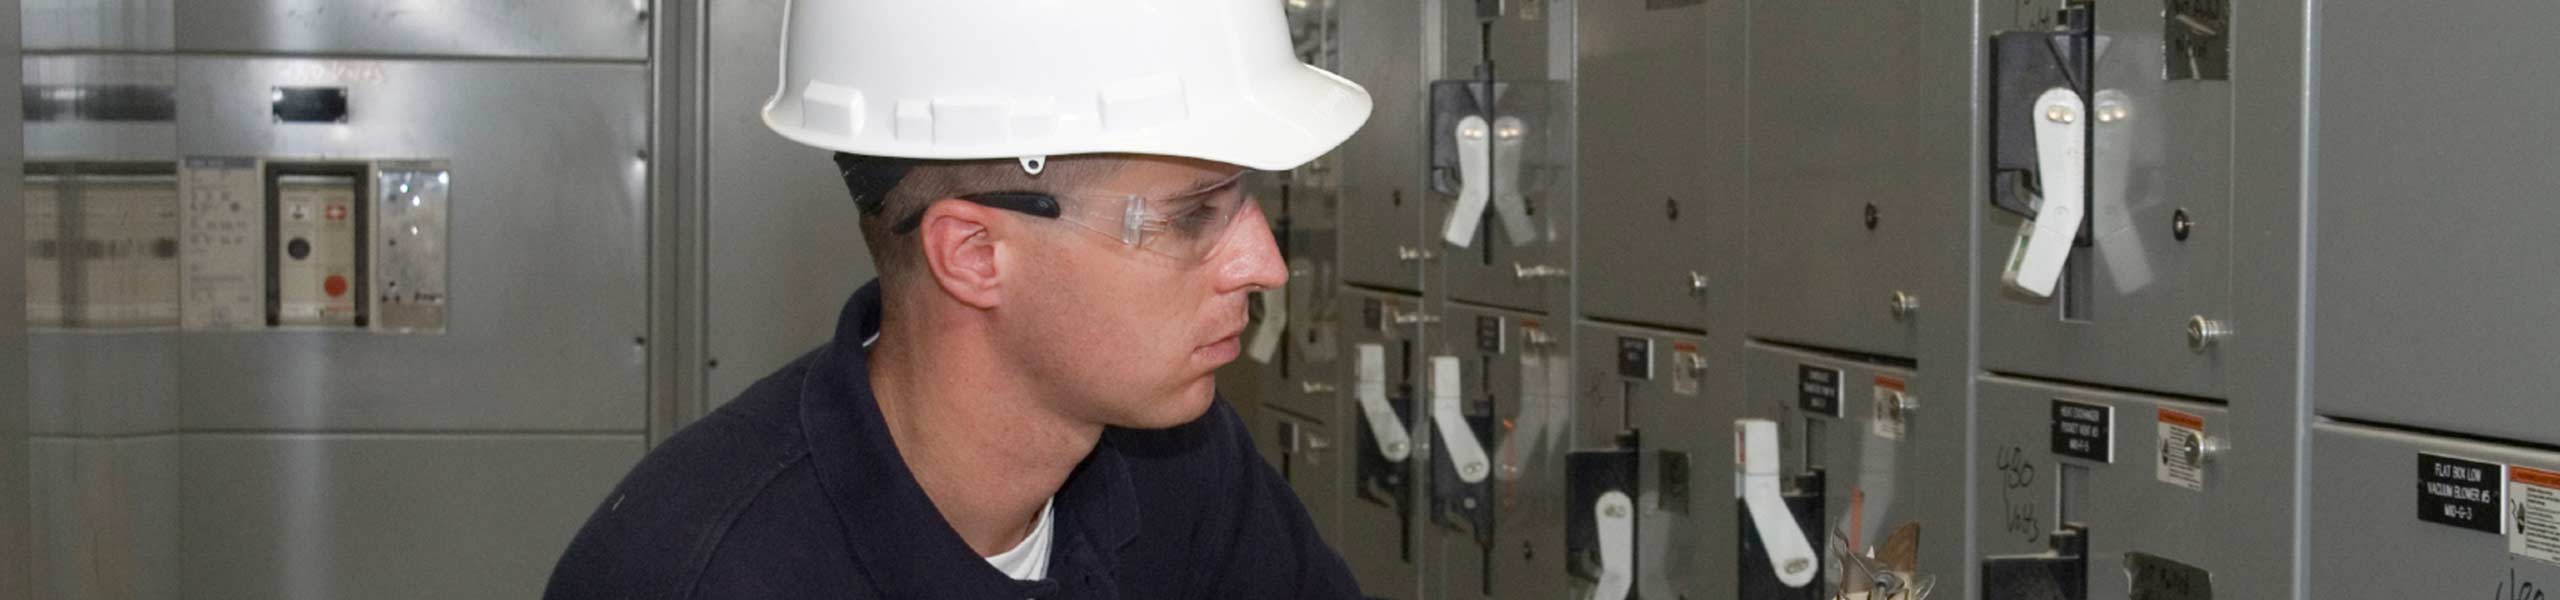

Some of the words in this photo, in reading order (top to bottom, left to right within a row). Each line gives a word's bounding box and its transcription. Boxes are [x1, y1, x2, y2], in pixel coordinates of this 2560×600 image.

[1996, 446, 2034, 492] 480
[2434, 462, 2451, 478] FLAT
[2452, 465, 2466, 480] BOX
[2467, 467, 2482, 482] LOW
[2426, 481, 2453, 497] VACUUM
[2454, 485, 2480, 502] BLOWER
